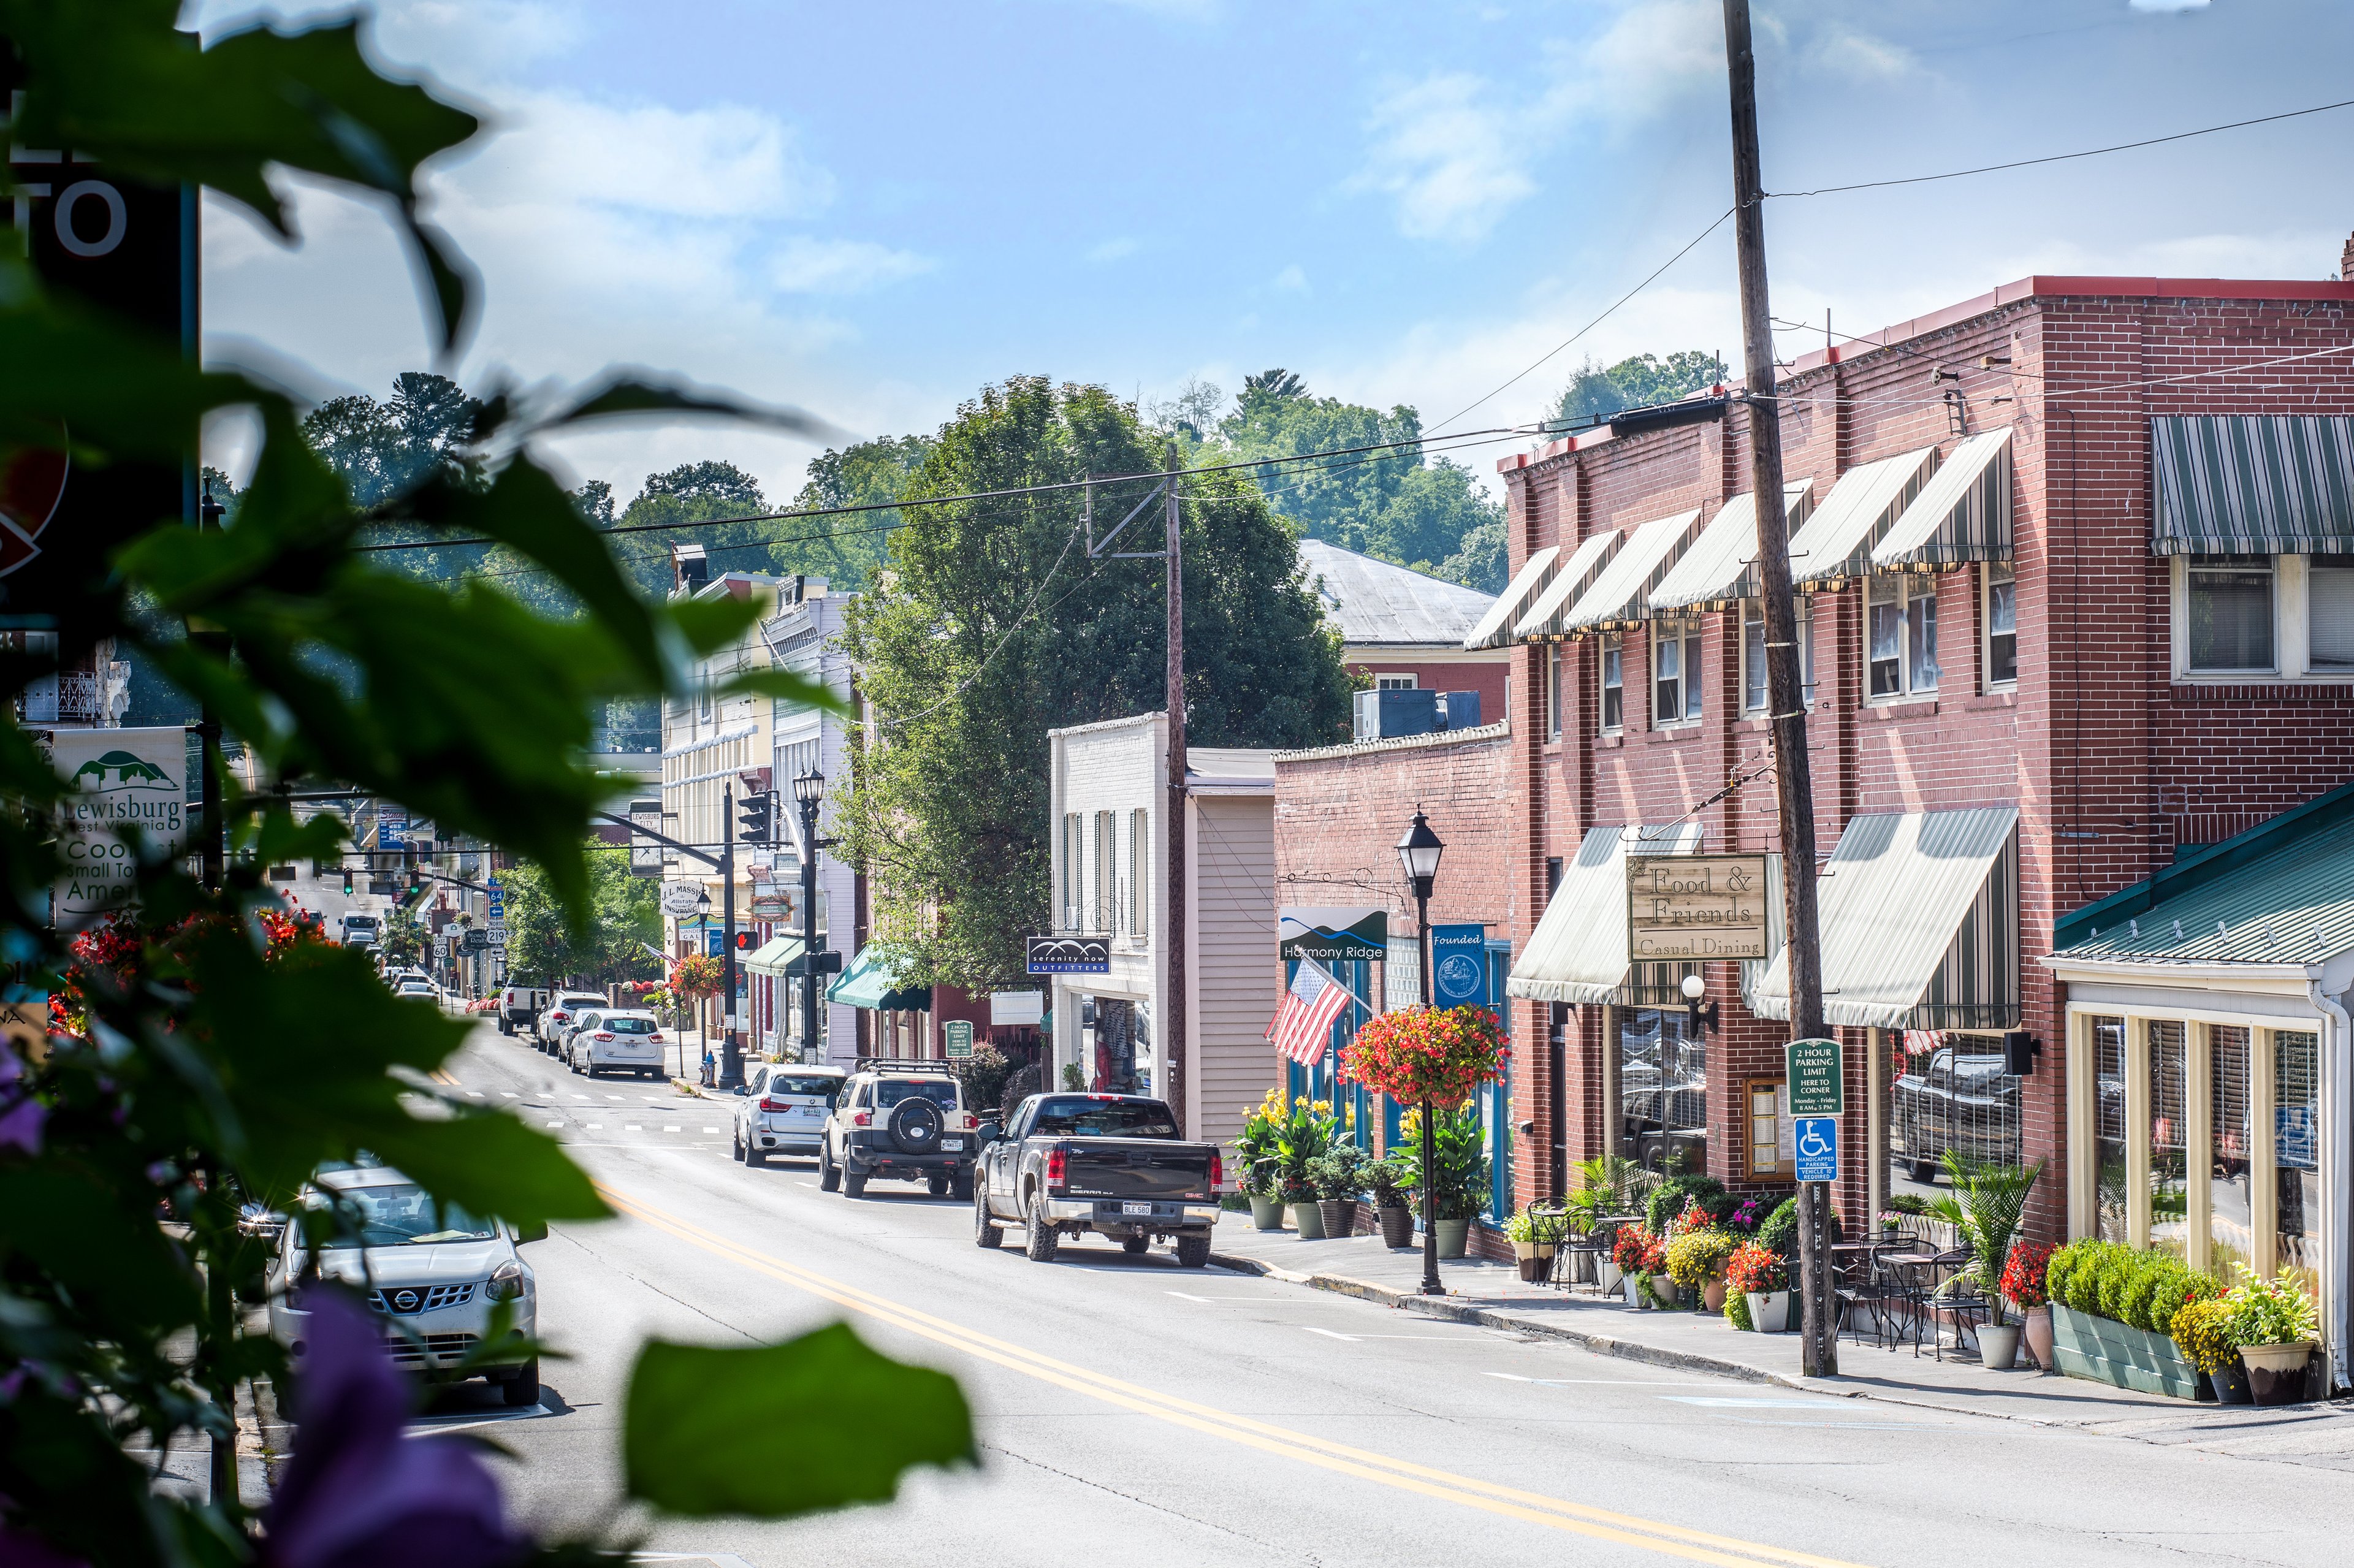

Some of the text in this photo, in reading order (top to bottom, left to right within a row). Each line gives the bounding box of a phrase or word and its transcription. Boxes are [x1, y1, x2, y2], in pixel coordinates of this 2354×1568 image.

[63, 794, 181, 831] Lewisburg
[67, 839, 177, 859] Coolst
[67, 862, 109, 878] Small
[1650, 866, 1753, 894] Food &
[665, 904, 698, 914] INSURANC
[1650, 897, 1750, 923] Friends
[489, 932, 504, 941] 219
[1434, 934, 1482, 946] Founded
[1346, 946, 1383, 959] Ridge
[1639, 938, 1759, 956] Casual Dining
[1796, 1058, 1834, 1067] PARKING
